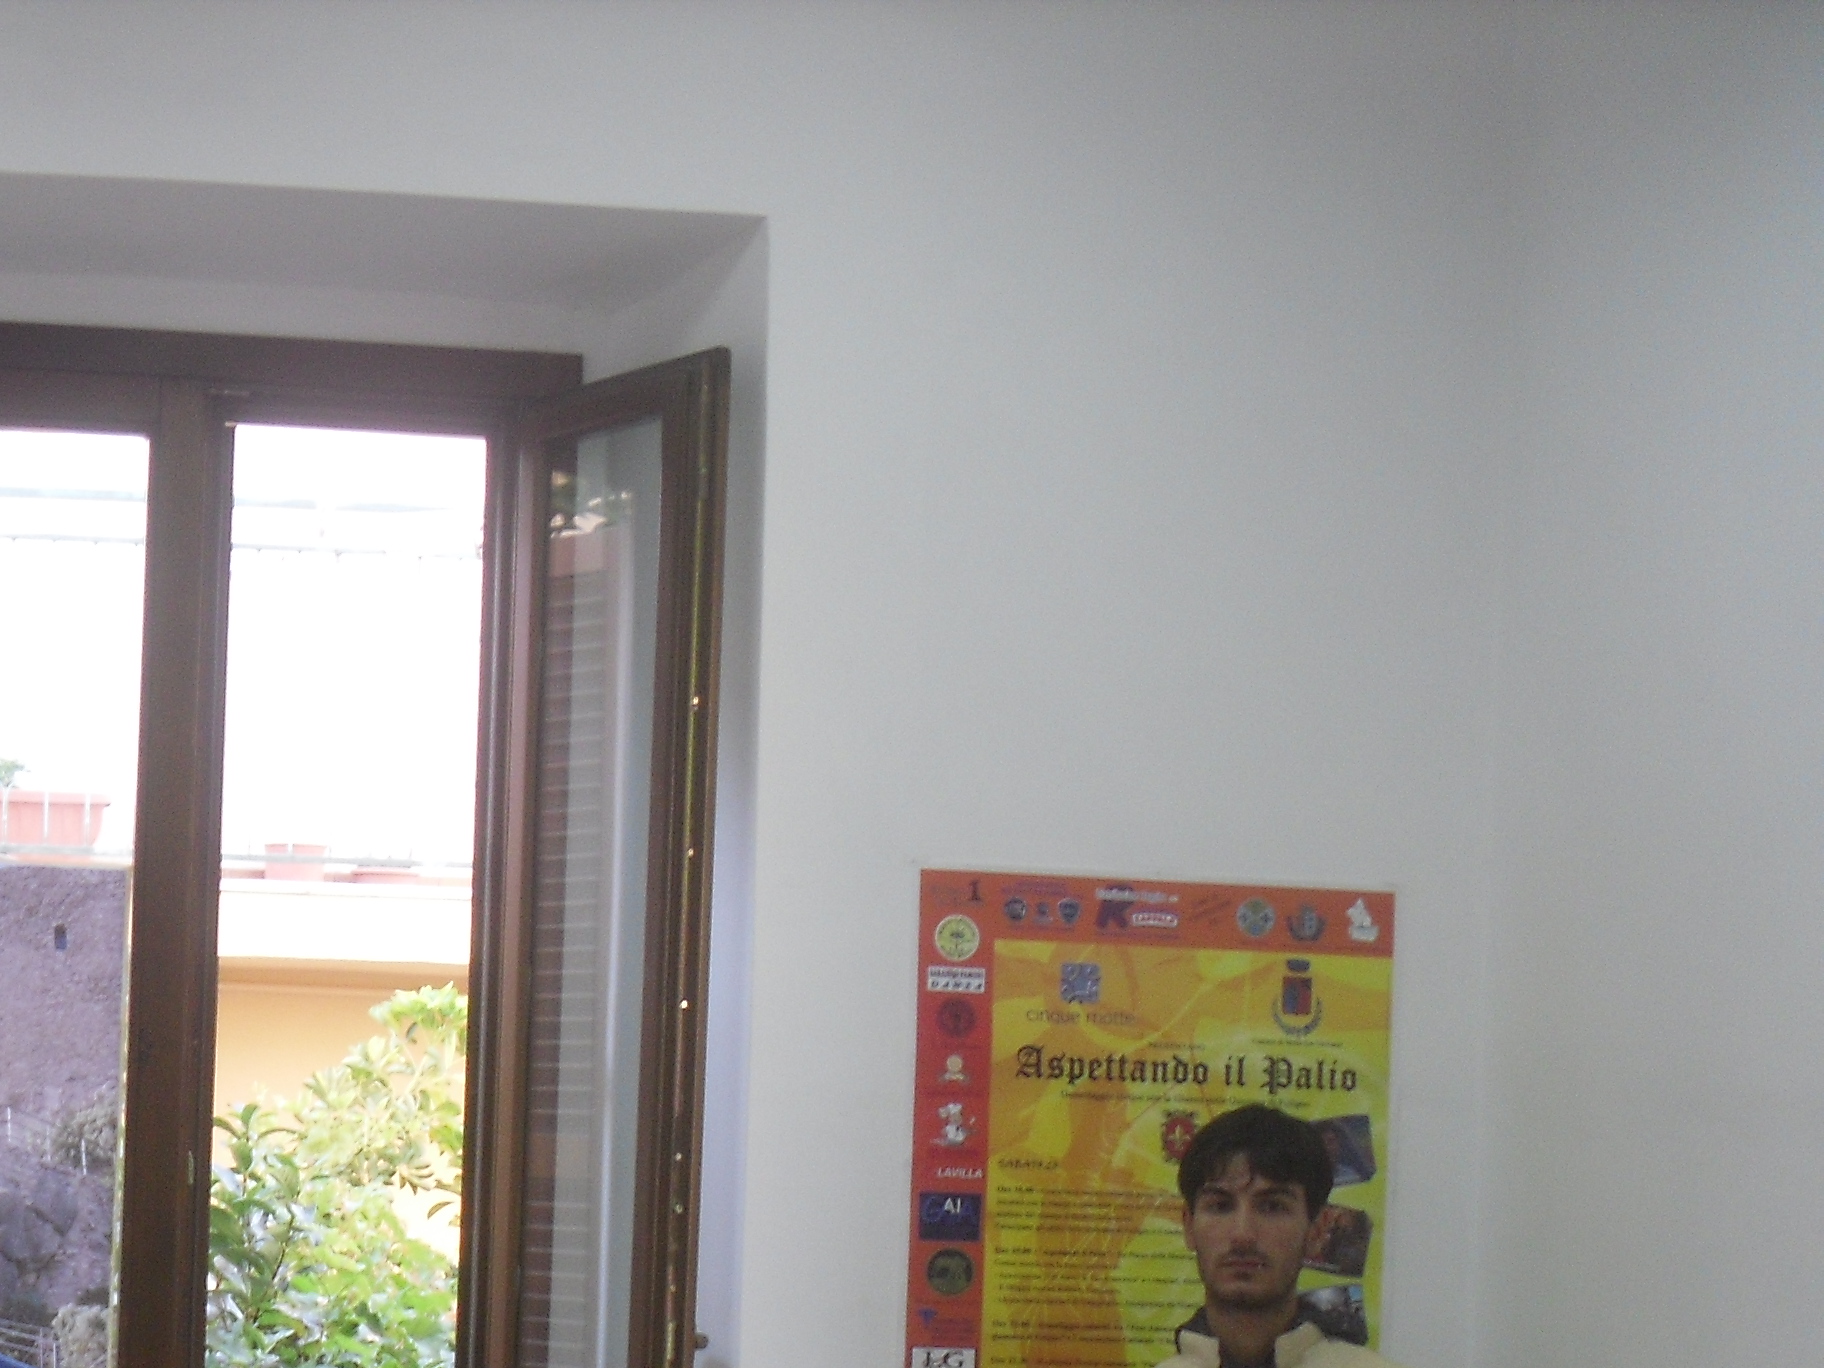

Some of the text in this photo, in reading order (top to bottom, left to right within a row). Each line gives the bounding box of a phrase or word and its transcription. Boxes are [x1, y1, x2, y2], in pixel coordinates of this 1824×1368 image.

[1014, 1045, 1357, 1097] Aspettando il Palio
[936, 1167, 983, 1180] LAVILLA
